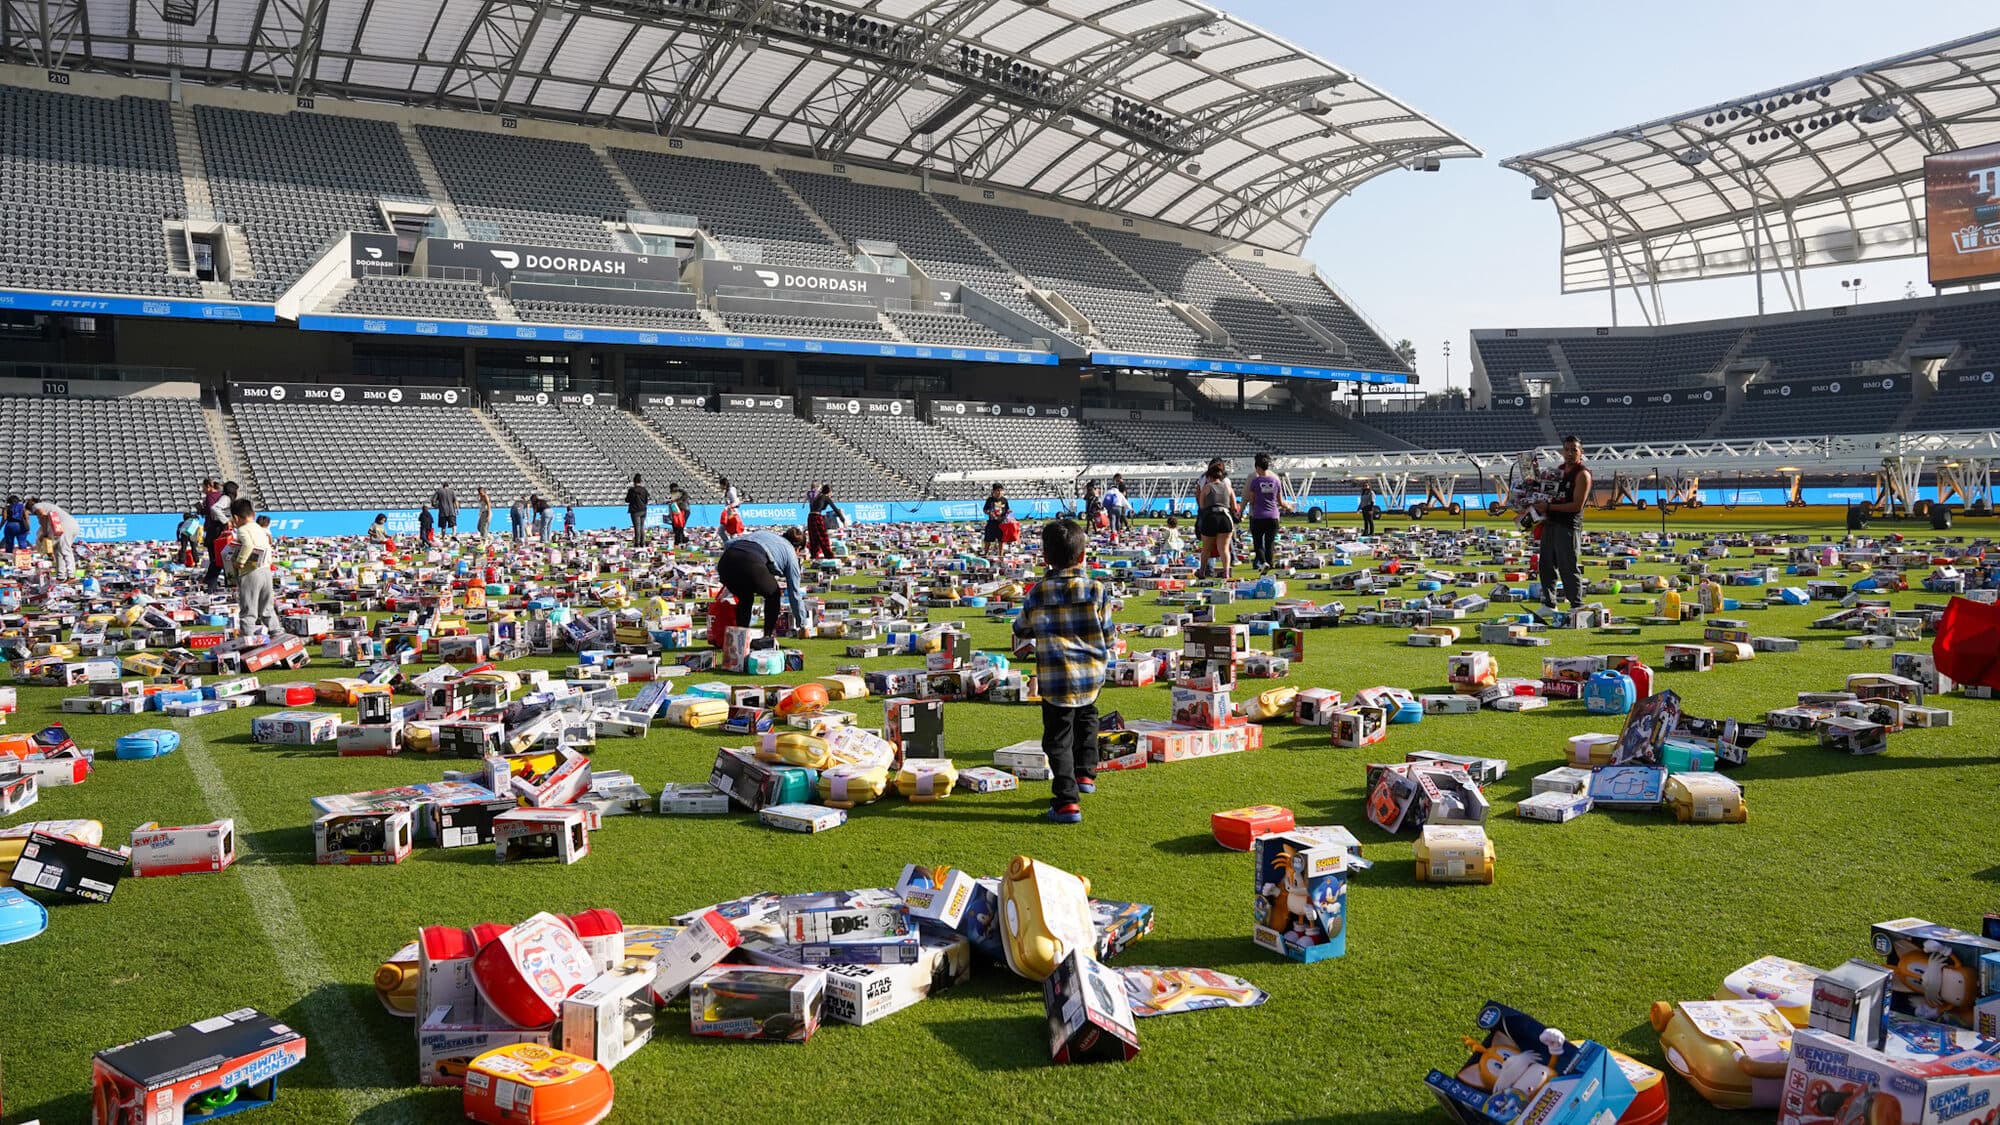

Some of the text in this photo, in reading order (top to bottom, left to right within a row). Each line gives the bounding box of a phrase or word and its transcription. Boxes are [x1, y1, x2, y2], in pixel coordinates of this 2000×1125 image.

[50, 74, 68, 83] 210
[299, 99, 312, 107] 211
[453, 242, 464, 250] M1
[526, 254, 626, 274] DOORDASH
[785, 274, 867, 292] DOORDASH
[50, 299, 109, 309] RITFIT
[1959, 374, 1978, 383] BMO
[46, 383, 65, 393] 110
[244, 389, 442, 400] BMO BMO BMO BMO
[1763, 381, 1881, 395] BMO BMO BMO
[826, 402, 889, 412] BMO BMO
[742, 508, 797, 518] MEMEHOUSE
[1315, 856, 1341, 867] SONIC
[948, 884, 966, 916] SONIC
[867, 976, 892, 992] STAR
[867, 983, 892, 1000] WARS
[1795, 1044, 1849, 1065] VENOM
[223, 1048, 285, 1086] TUMBLER
[252, 1053, 297, 1083] VENOM
[1805, 1060, 1880, 1087] TUMBLER
[1929, 1083, 1970, 1113] VENOM
[1936, 1089, 1990, 1124] TUMBLER
